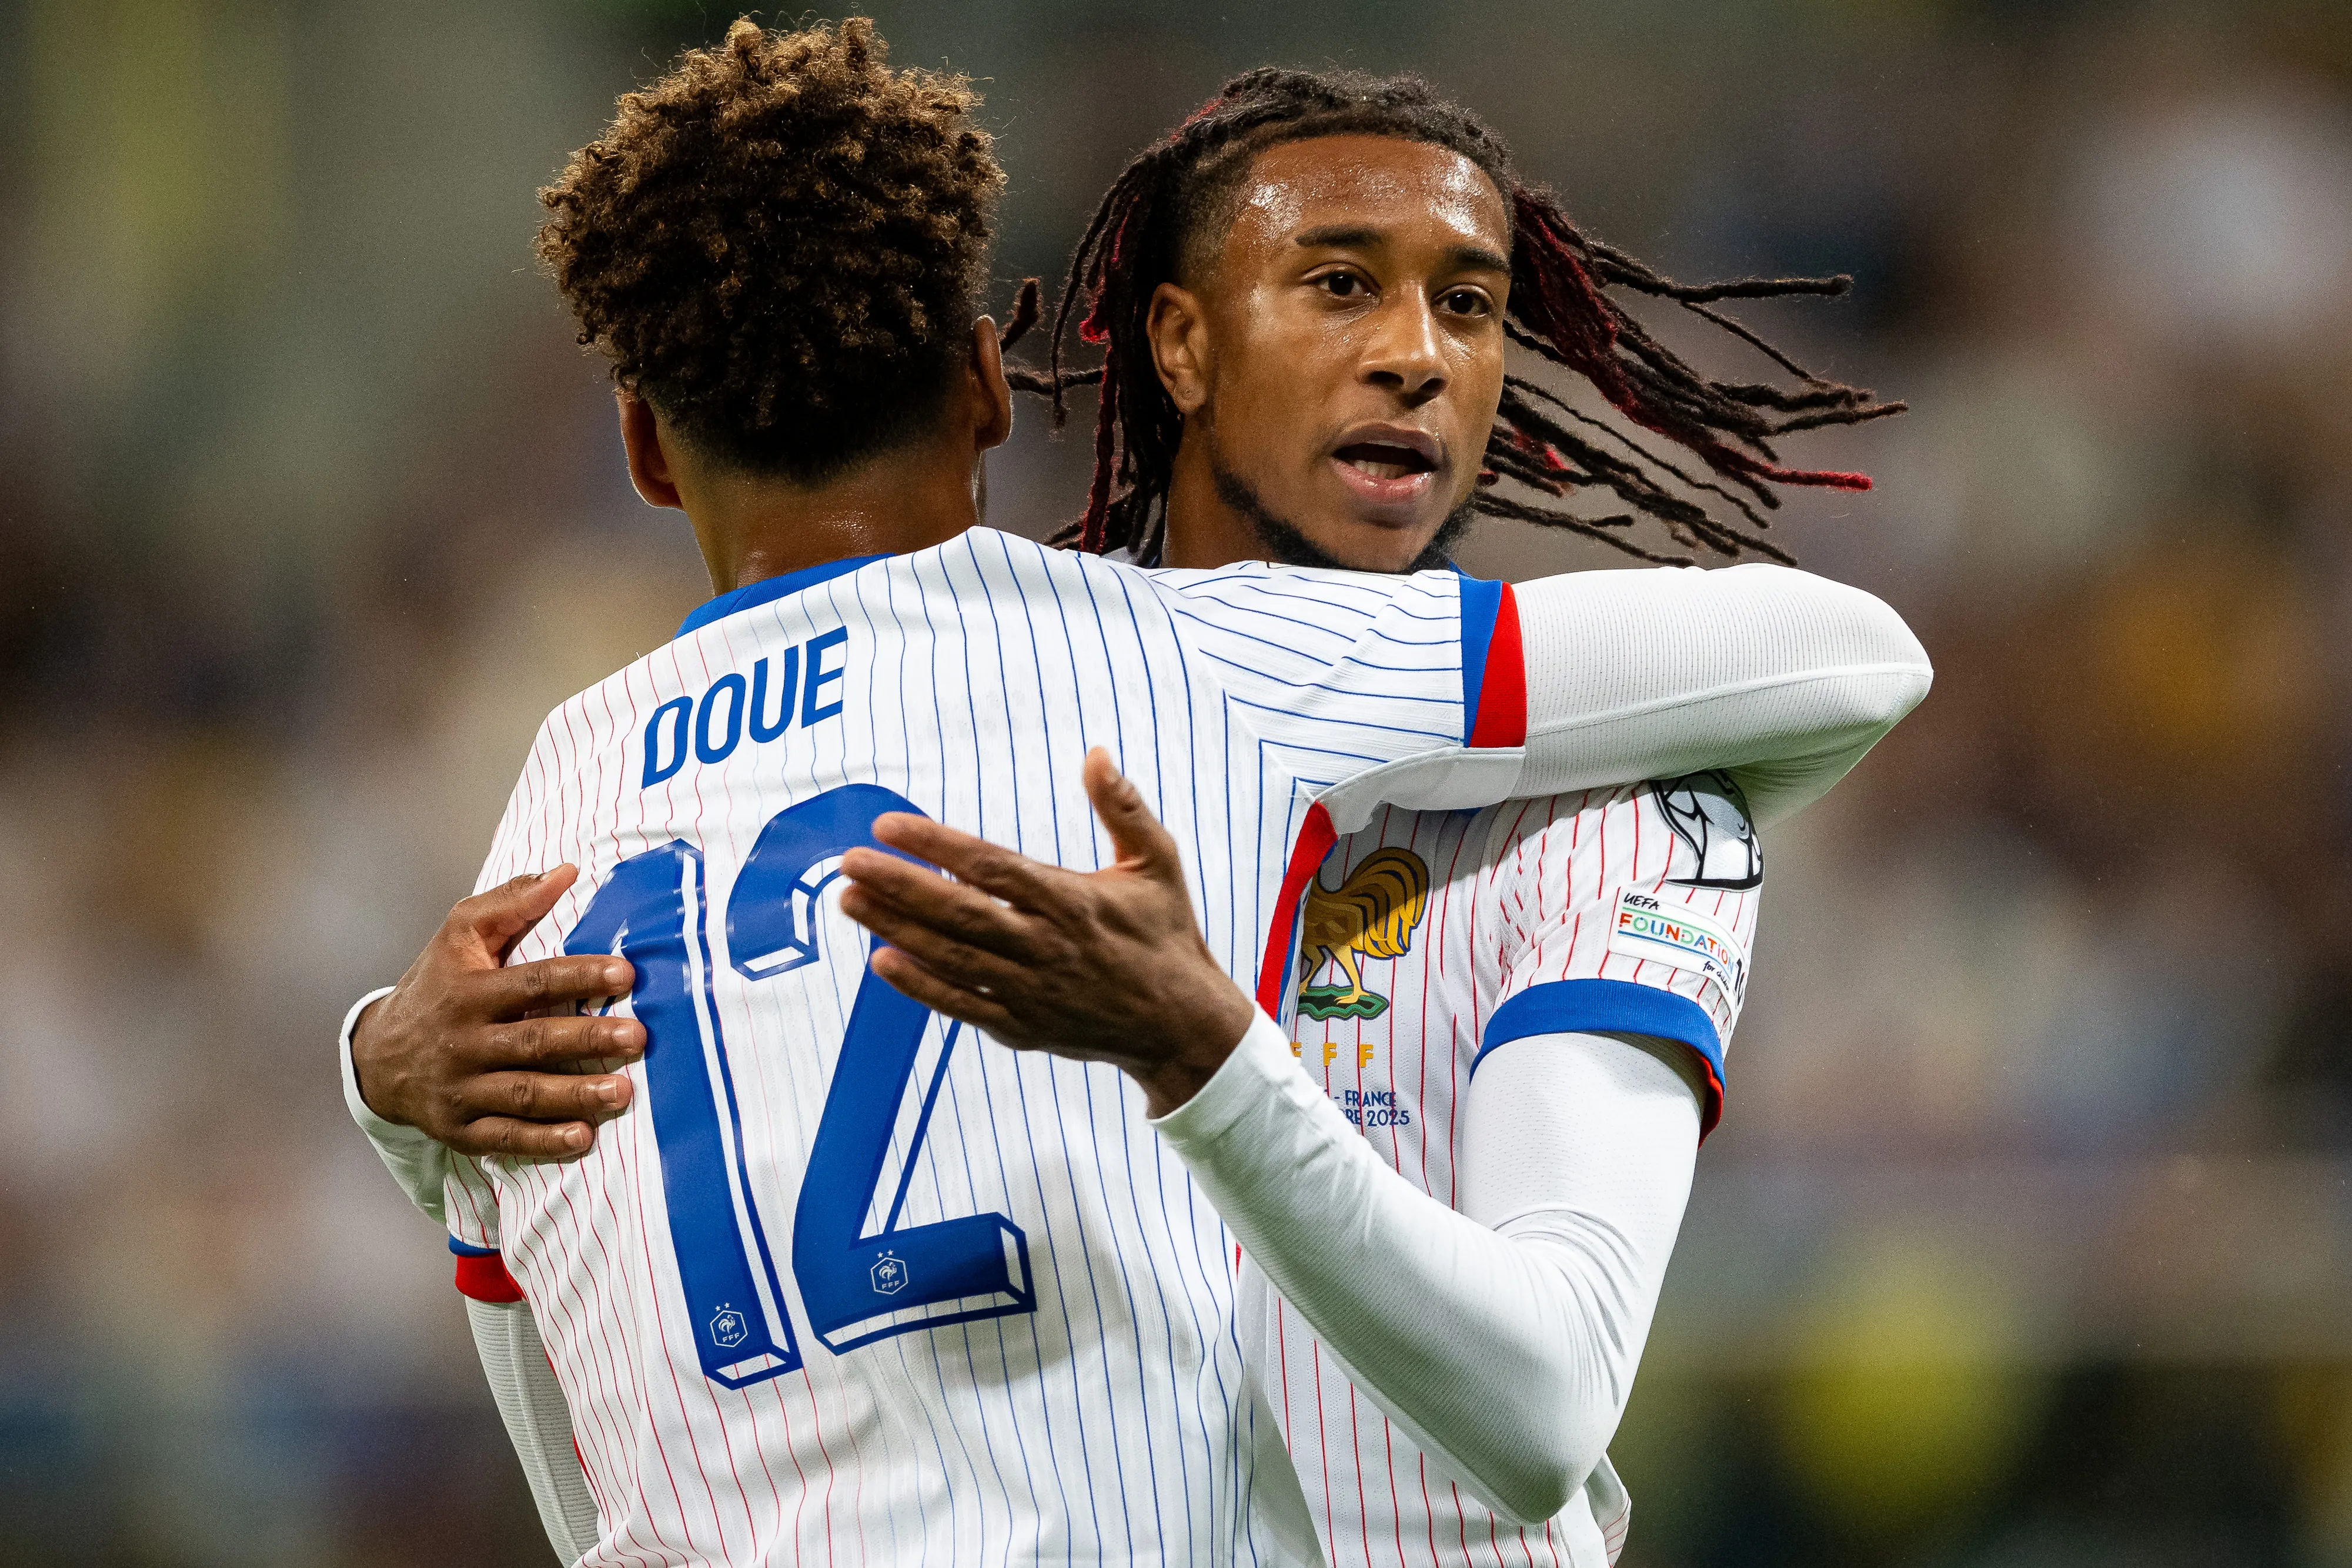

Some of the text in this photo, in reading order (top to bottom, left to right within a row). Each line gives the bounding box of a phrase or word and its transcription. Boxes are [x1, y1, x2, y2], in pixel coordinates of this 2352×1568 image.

[642, 625, 848, 789] DOUE
[1623, 892, 1660, 910] UEFA
[1619, 912, 1734, 974] FOUNDATION
[1703, 961, 1715, 972] for
[563, 783, 1037, 1390] 12
[1344, 1089, 1396, 1107] FRANCE
[1367, 1109, 1410, 1127] 2025
[881, 1279, 900, 1289] FFF
[722, 1332, 740, 1342] FFF
